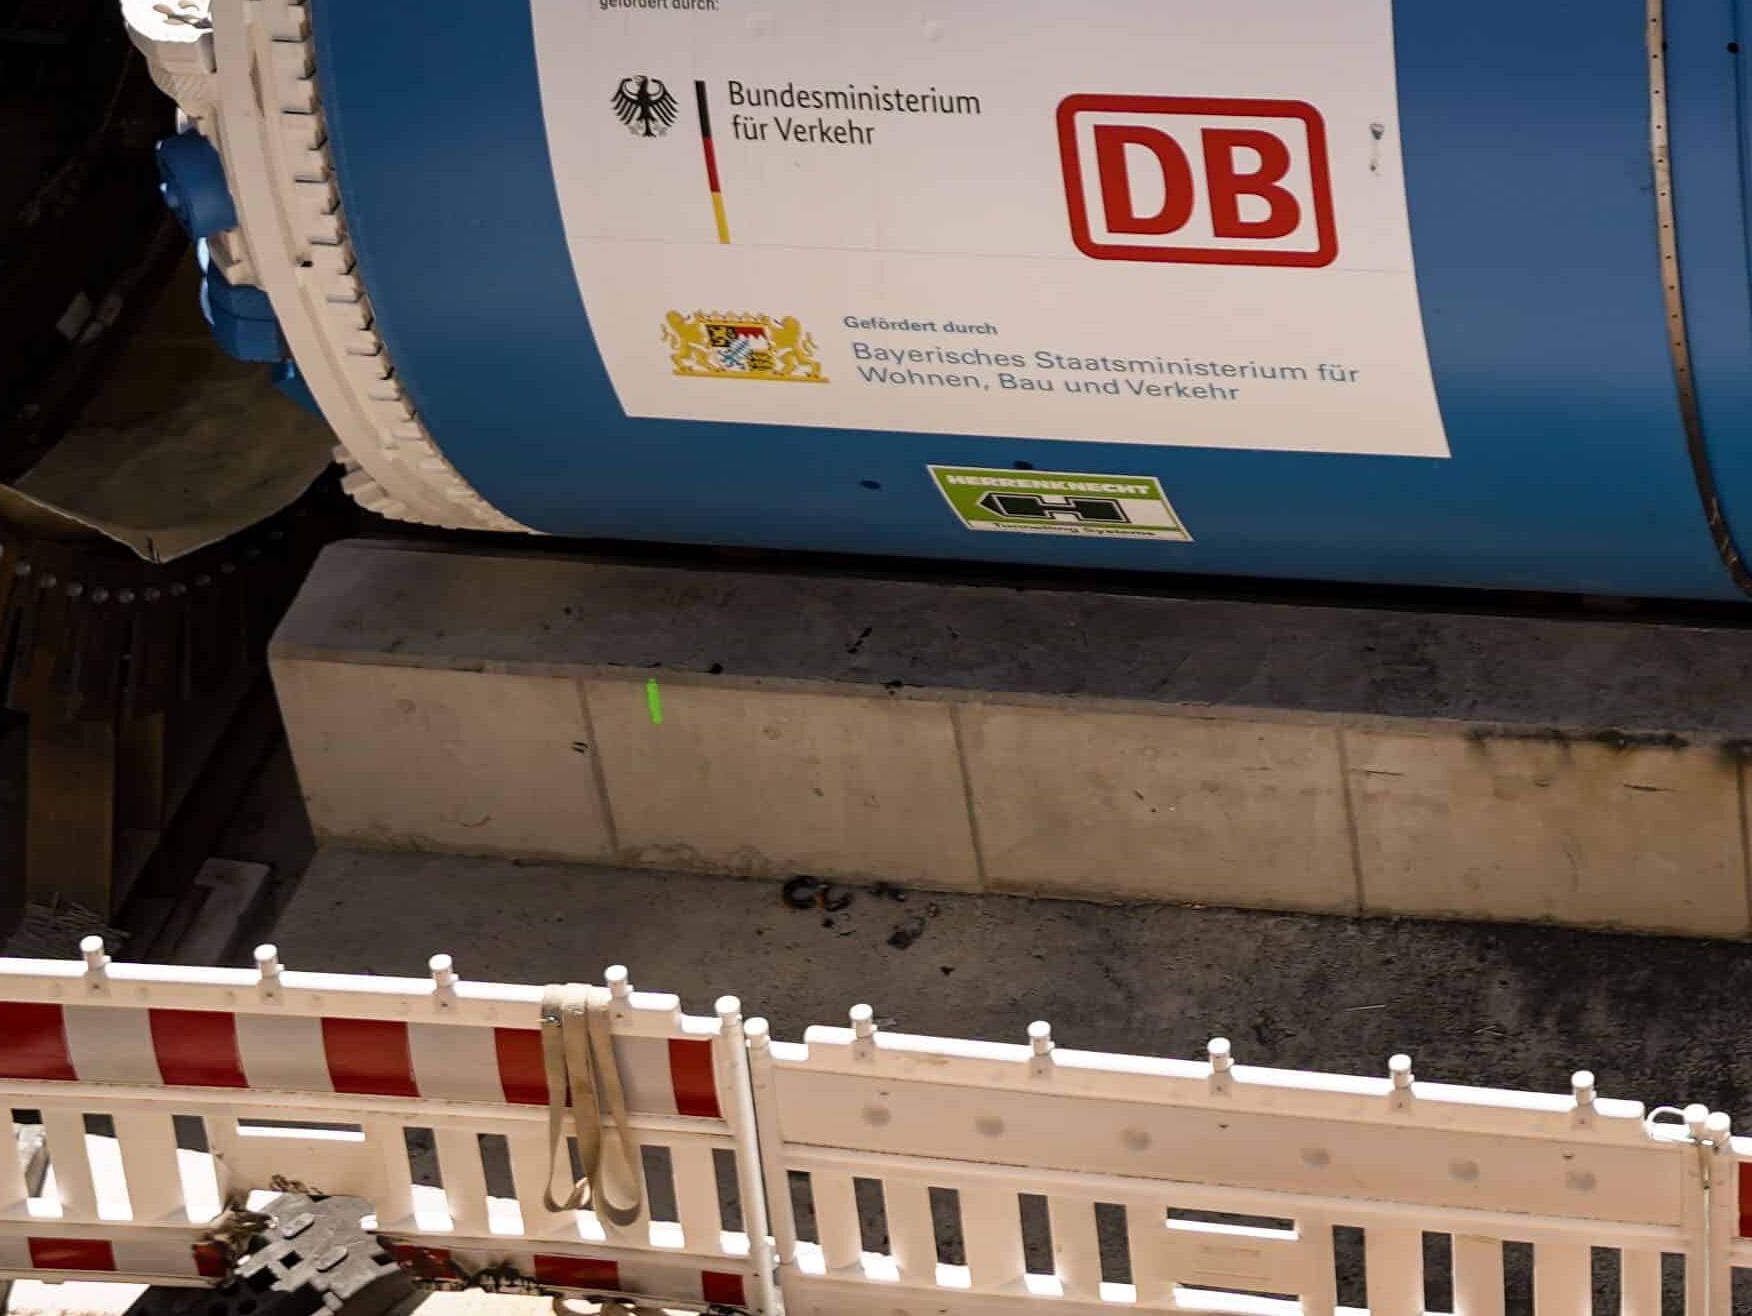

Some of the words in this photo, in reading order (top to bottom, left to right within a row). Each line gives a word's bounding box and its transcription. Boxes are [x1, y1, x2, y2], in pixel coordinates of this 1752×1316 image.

[728, 80, 981, 114] Bundesministerium
[732, 114, 768, 140] für
[774, 117, 875, 145] Verkehr
[1093, 125, 1300, 239] DB
[844, 316, 937, 333] Gefördert
[943, 320, 998, 335] durch
[852, 341, 1026, 368] Bayerisches
[1034, 350, 1308, 381] Staatsministerium
[1317, 362, 1361, 383] für
[856, 366, 990, 391] Wohnen,
[998, 373, 1054, 392] Bau
[1065, 379, 1120, 395] und
[1126, 379, 1240, 400] Verkehr
[947, 474, 1150, 495] HERRENKNECHT
